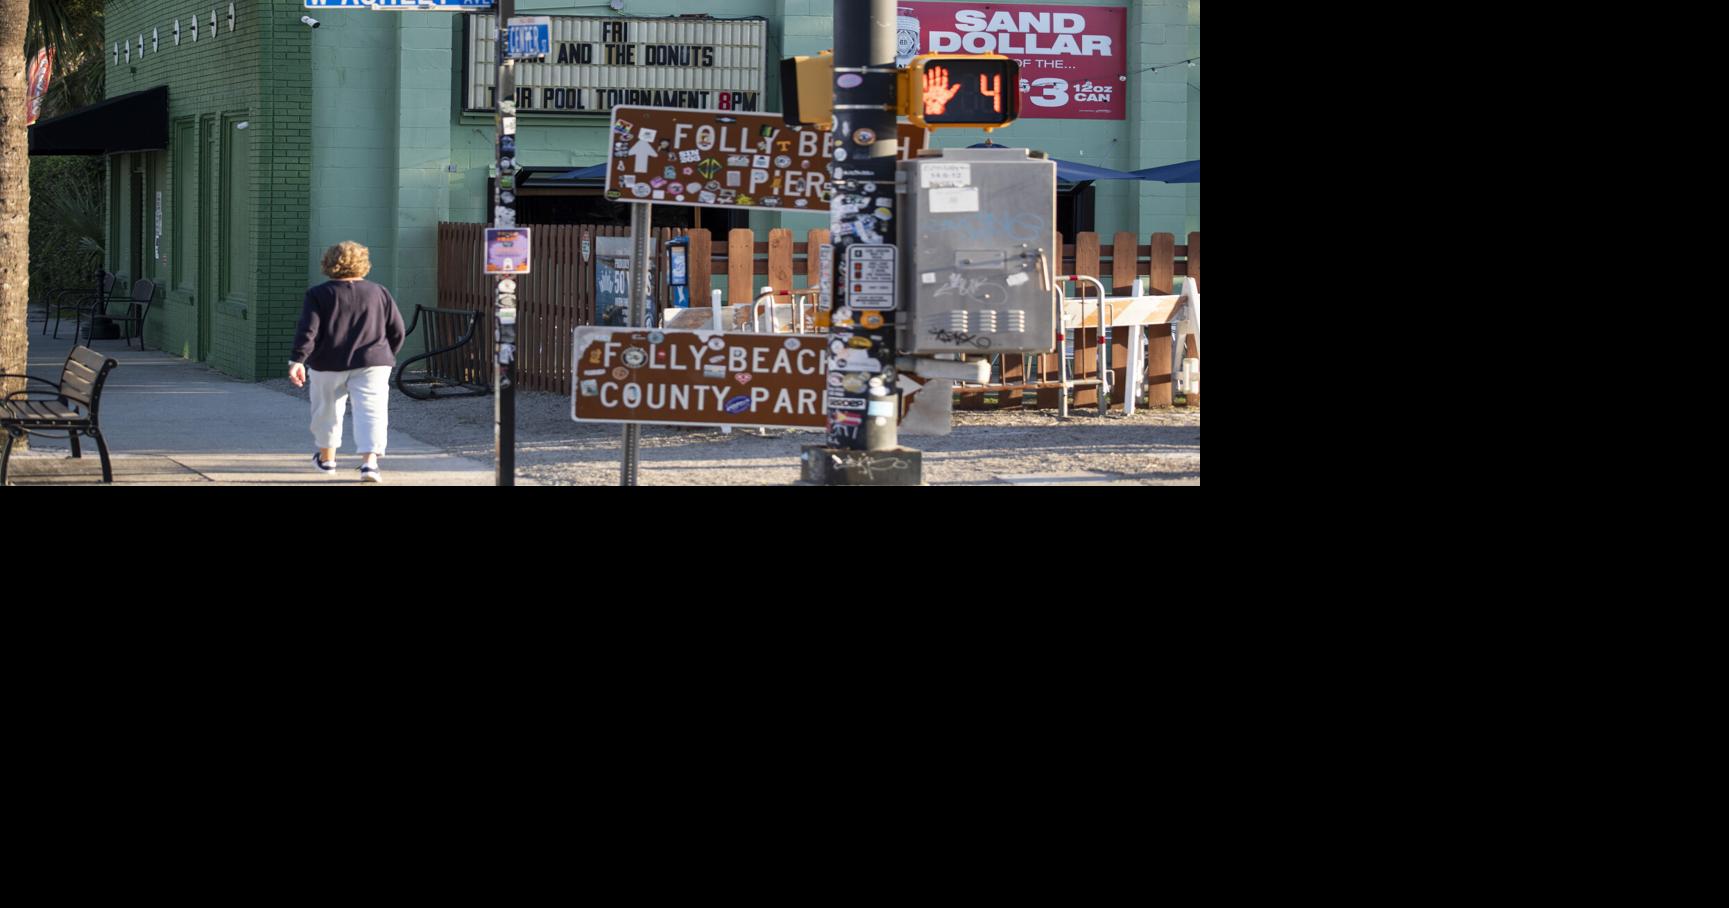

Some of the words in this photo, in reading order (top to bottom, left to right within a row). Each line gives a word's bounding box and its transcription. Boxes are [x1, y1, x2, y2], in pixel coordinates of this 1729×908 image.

[603, 21, 628, 43] FRI
[954, 9, 1086, 34] SAND
[557, 43, 592, 65] AND
[605, 44, 636, 66] THE
[645, 45, 713, 67] DONUTS
[928, 31, 1113, 56] DOLLAR
[1035, 59, 1076, 69] THE...
[543, 88, 585, 110] POOL
[596, 88, 710, 110] TOURNAMENT
[718, 91, 758, 112] 8PM
[980, 73, 1001, 113] 4
[1074, 93, 1111, 102] CAN
[673, 123, 780, 154] FOLLY
[798, 130, 910, 160] BEH
[748, 168, 825, 198] PIER
[614, 270, 625, 294] 50
[603, 342, 708, 370] FLLY
[600, 381, 730, 412] COUNTY
[751, 387, 828, 415] PAR
